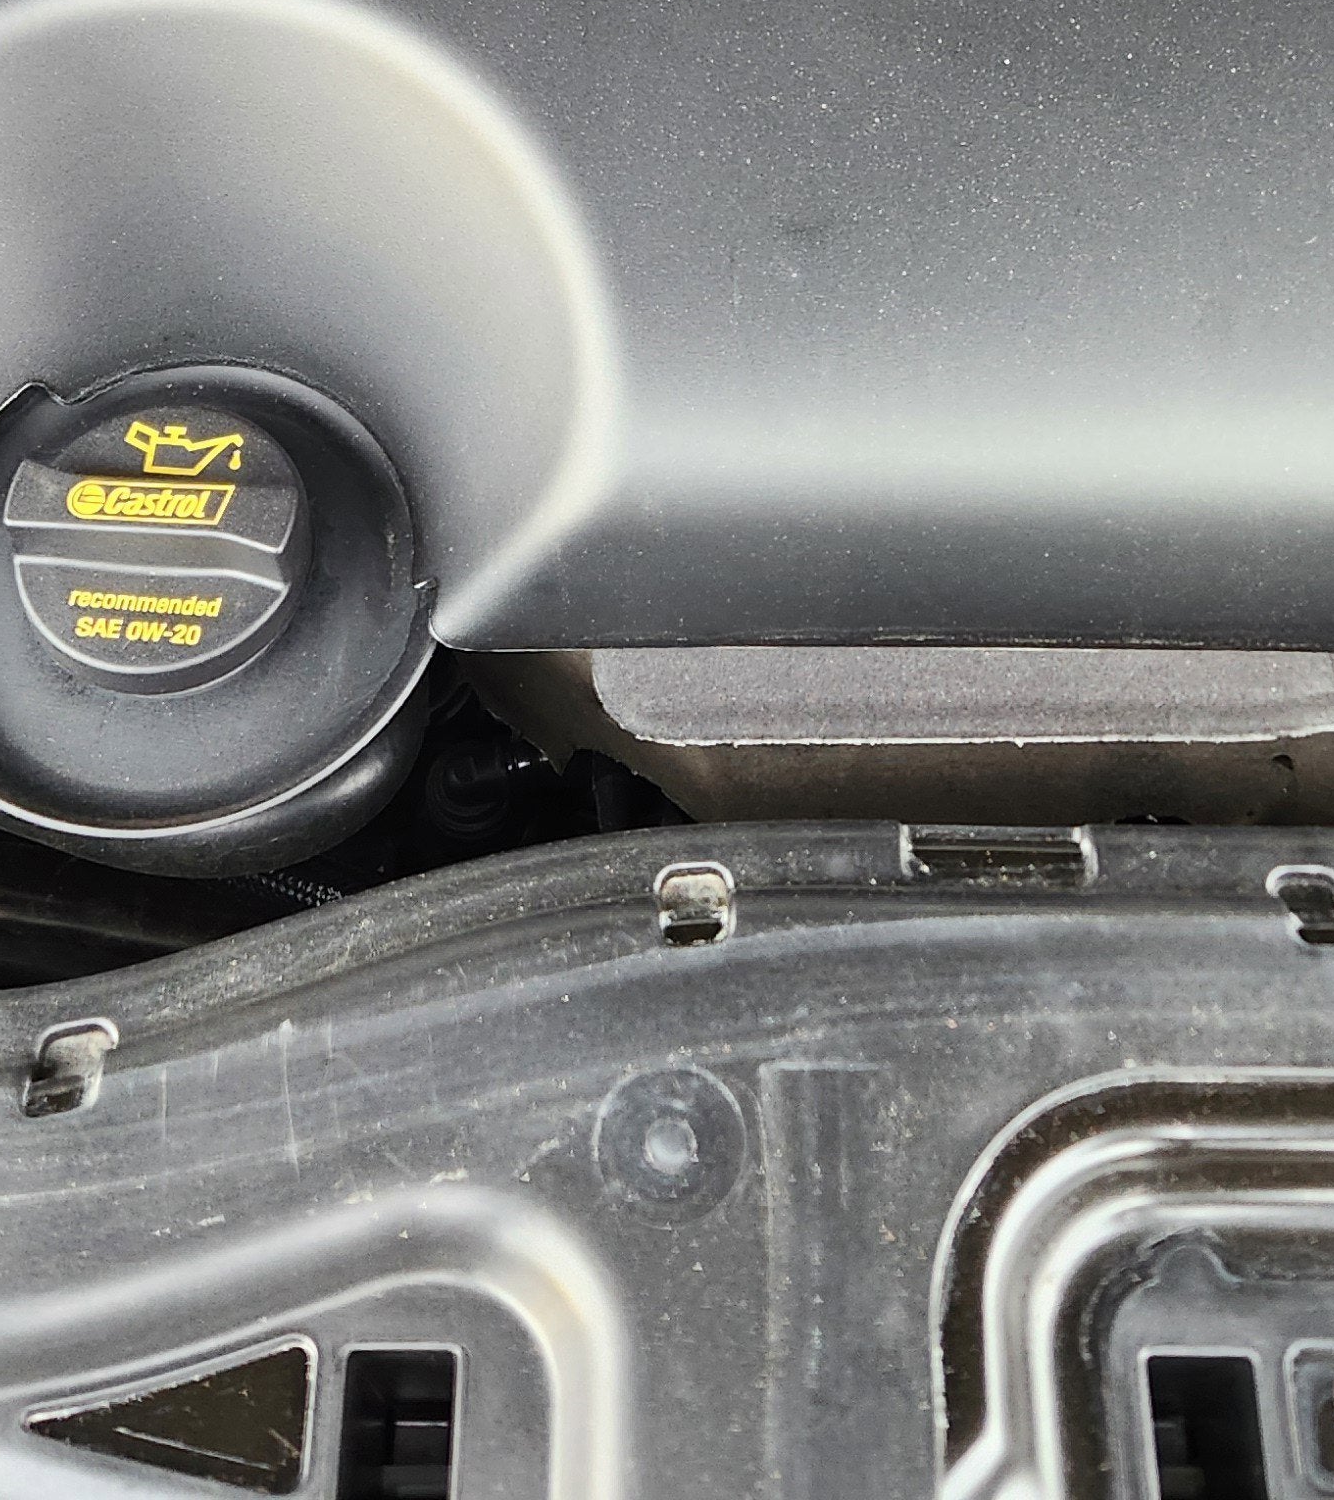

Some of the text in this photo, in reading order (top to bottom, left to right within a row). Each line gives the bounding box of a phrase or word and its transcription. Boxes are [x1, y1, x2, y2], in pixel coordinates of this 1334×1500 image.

[102, 486, 211, 519] Castrol
[68, 589, 223, 617] recommended
[74, 616, 202, 646] SAE 0W-20
